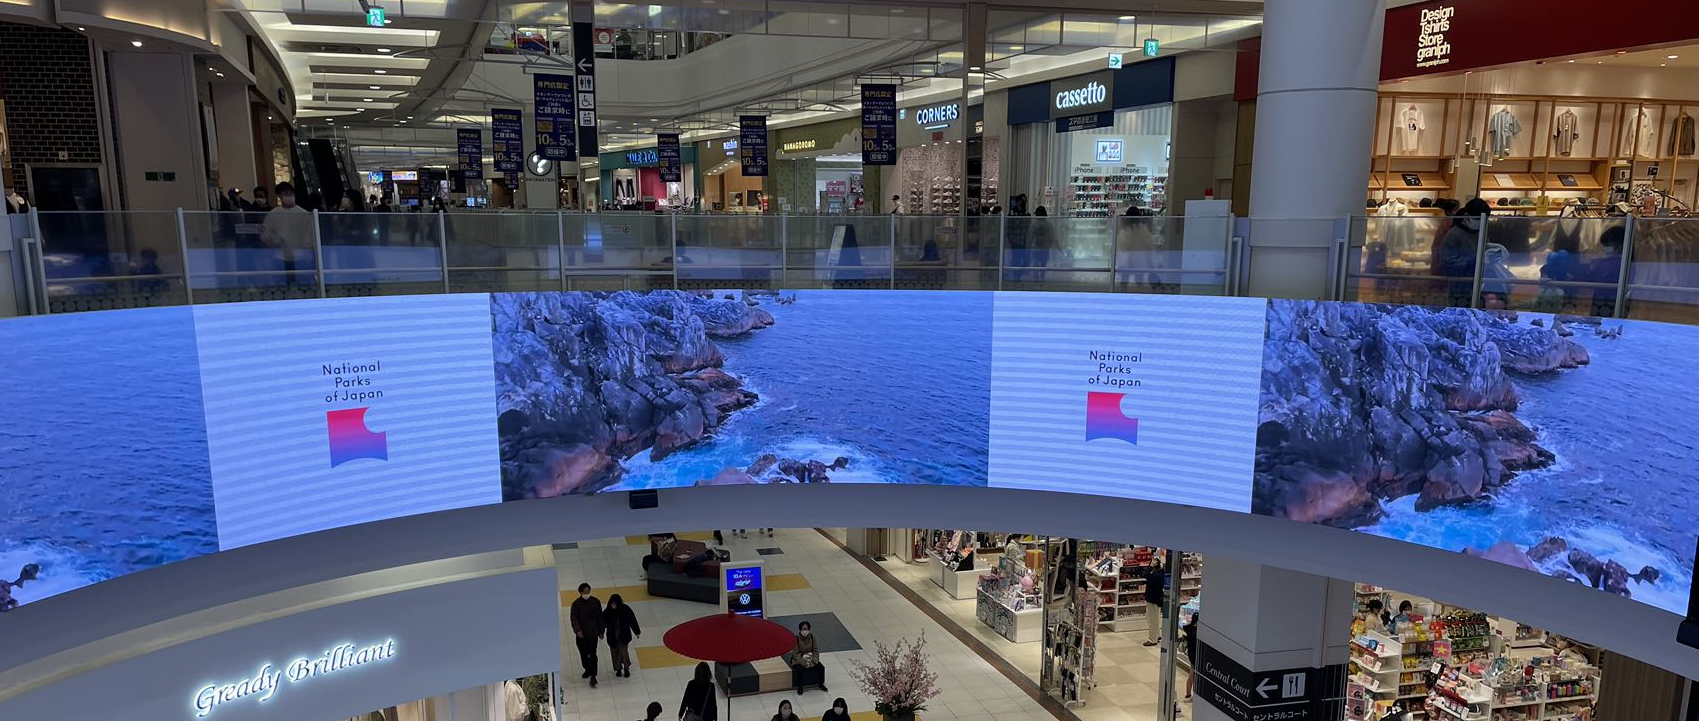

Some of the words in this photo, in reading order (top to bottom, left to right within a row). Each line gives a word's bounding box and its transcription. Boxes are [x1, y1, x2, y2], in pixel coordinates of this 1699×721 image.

[1421, 6, 1454, 22] Design
[1420, 19, 1450, 34] Tshirts
[1418, 34, 1444, 47] Store
[1417, 41, 1450, 61] graniph
[537, 80, 570, 90] 専門店限定
[1056, 81, 1106, 109] cassetto
[537, 106, 571, 115] ご請求時に
[916, 104, 958, 125] CORNERS
[1089, 350, 1142, 362] National
[322, 360, 381, 375] National
[1099, 362, 1131, 374] Parks
[335, 375, 371, 388] Parks
[1088, 374, 1100, 384] of
[1103, 375, 1141, 389] Japan
[325, 390, 338, 402] of
[342, 389, 383, 403] Japan
[194, 663, 281, 718] Gready
[286, 638, 396, 683] Brilliant
[1205, 662, 1230, 685] Central
[1230, 677, 1251, 698] Court
[1214, 692, 1250, 720] セントラルコート
[1252, 709, 1308, 721] セントラルコート
